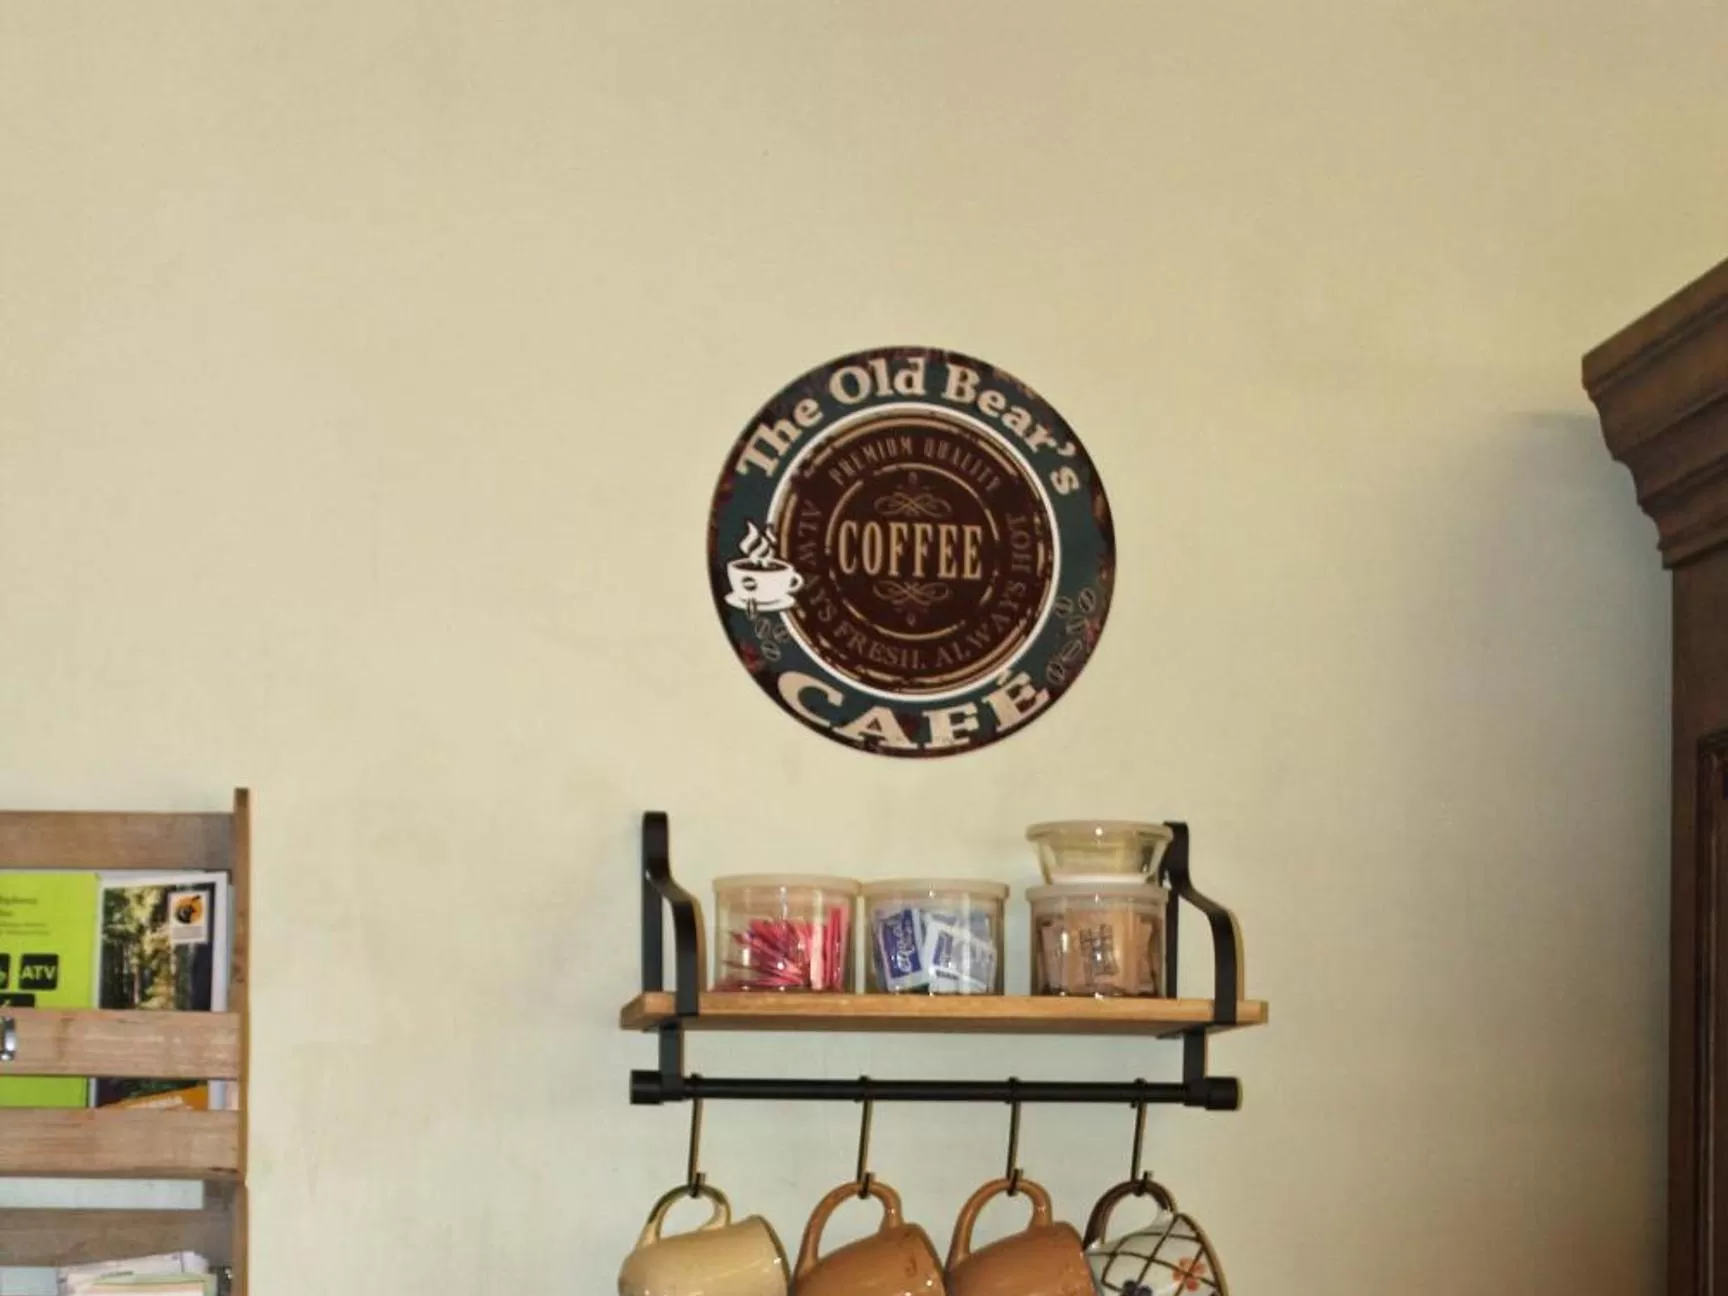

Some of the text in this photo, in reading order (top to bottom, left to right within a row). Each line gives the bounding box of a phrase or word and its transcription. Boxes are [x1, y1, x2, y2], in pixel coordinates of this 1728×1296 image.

[737, 356, 1081, 496] The Old Bear's
[828, 436, 1000, 492] PREMIUM QUALITY
[837, 520, 983, 580] COFFEE
[936, 580, 1027, 668] ALWAYS
[1005, 512, 1033, 573] HOT
[22, 964, 57, 980] ATV
